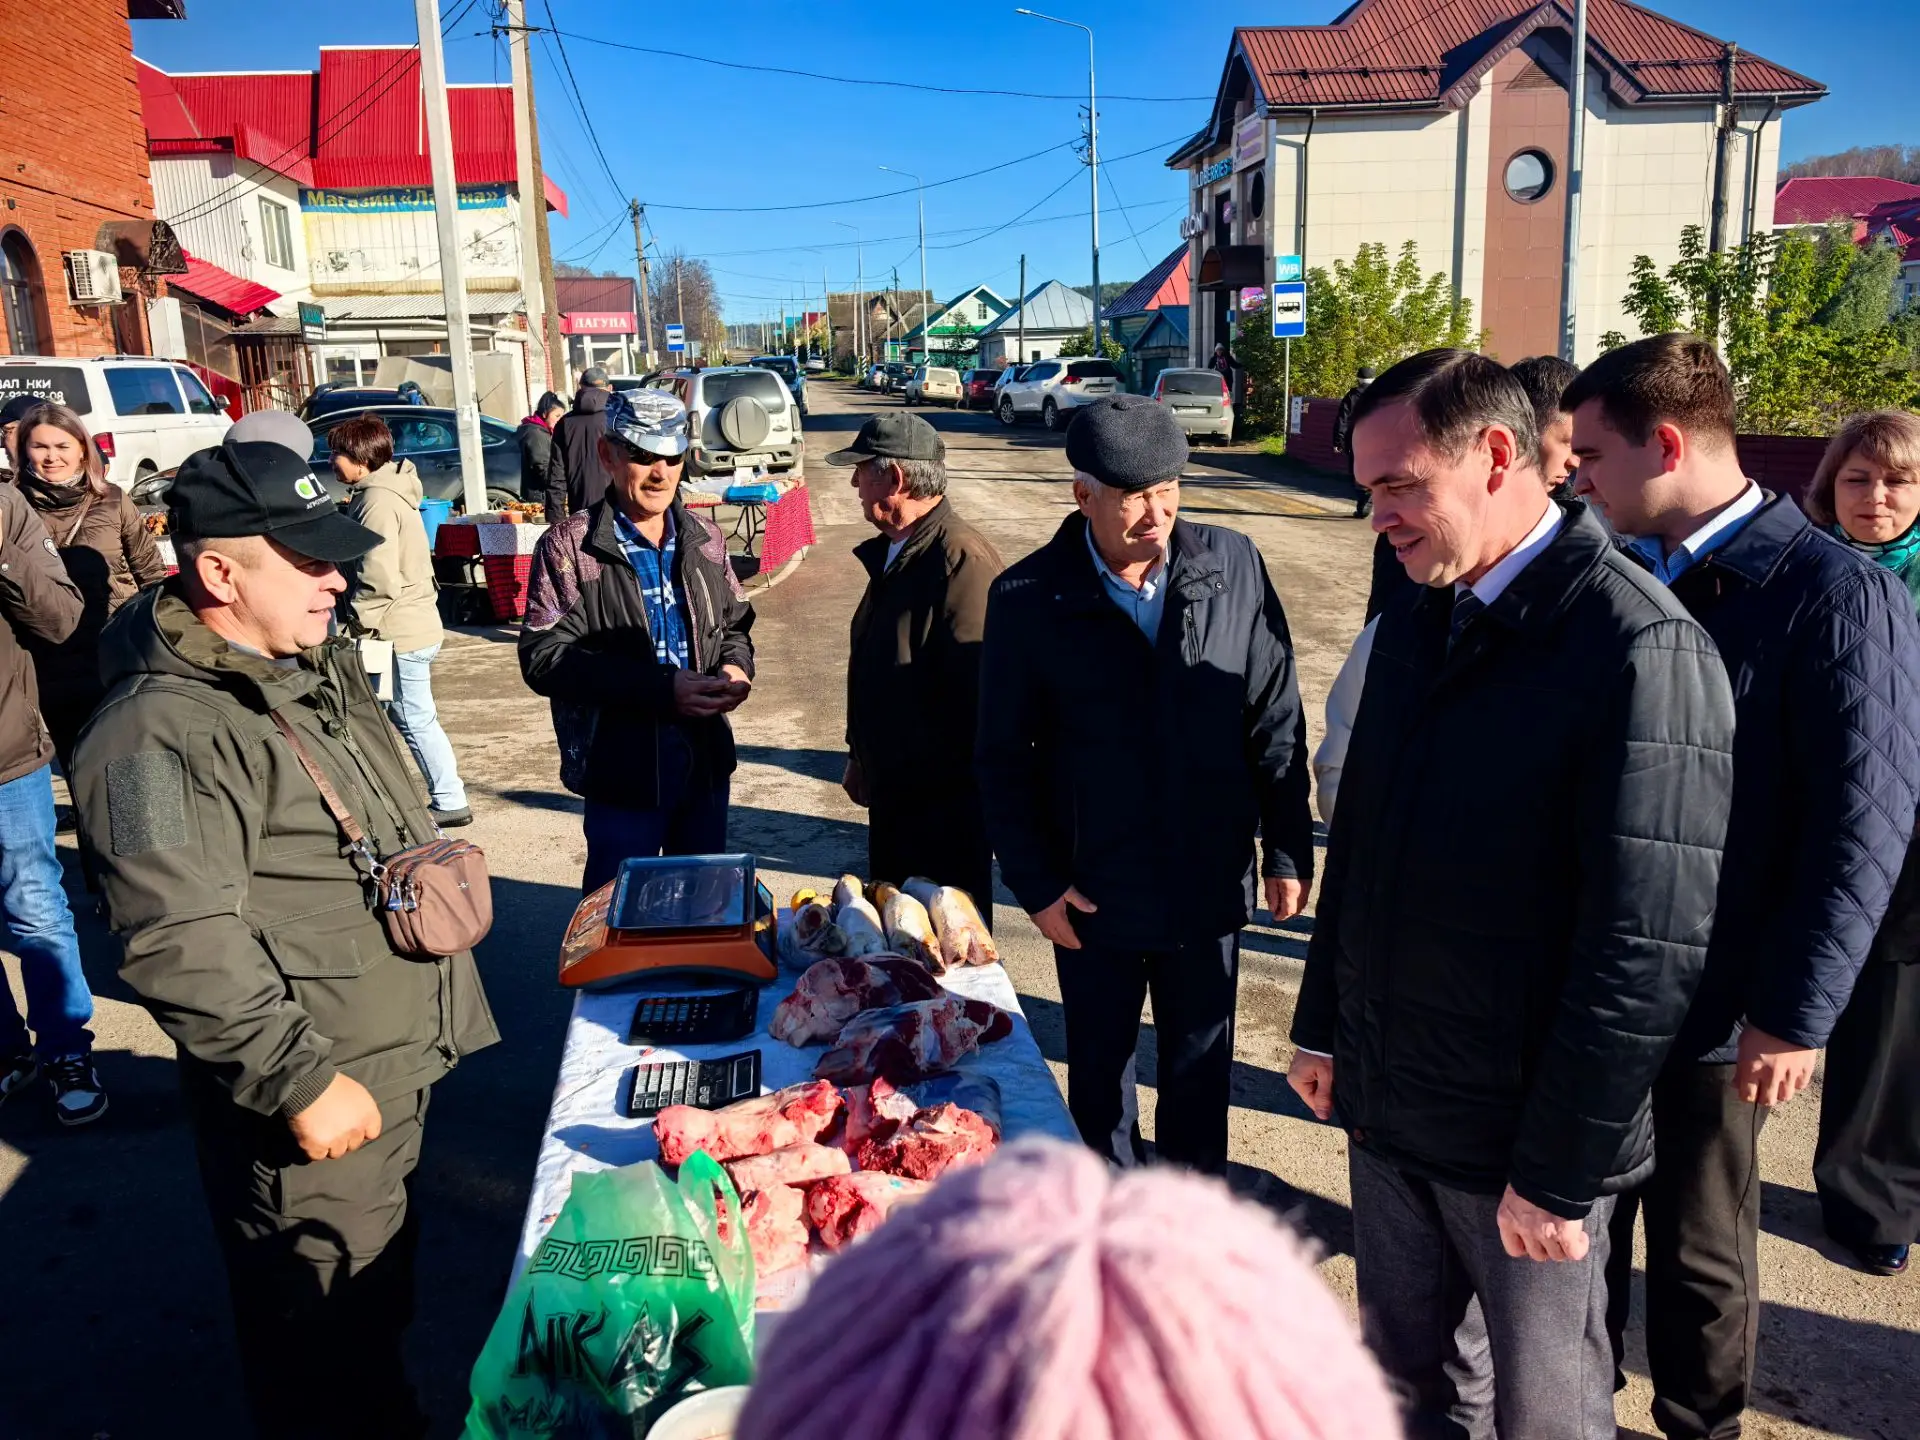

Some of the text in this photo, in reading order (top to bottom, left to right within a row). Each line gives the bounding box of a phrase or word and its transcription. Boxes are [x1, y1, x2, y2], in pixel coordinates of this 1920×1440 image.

[306, 189, 499, 208] Магазин «Лана»
[1180, 211, 1204, 238] OZON
[1280, 263, 1299, 275] WB
[26, 378, 52, 390] НКИ
